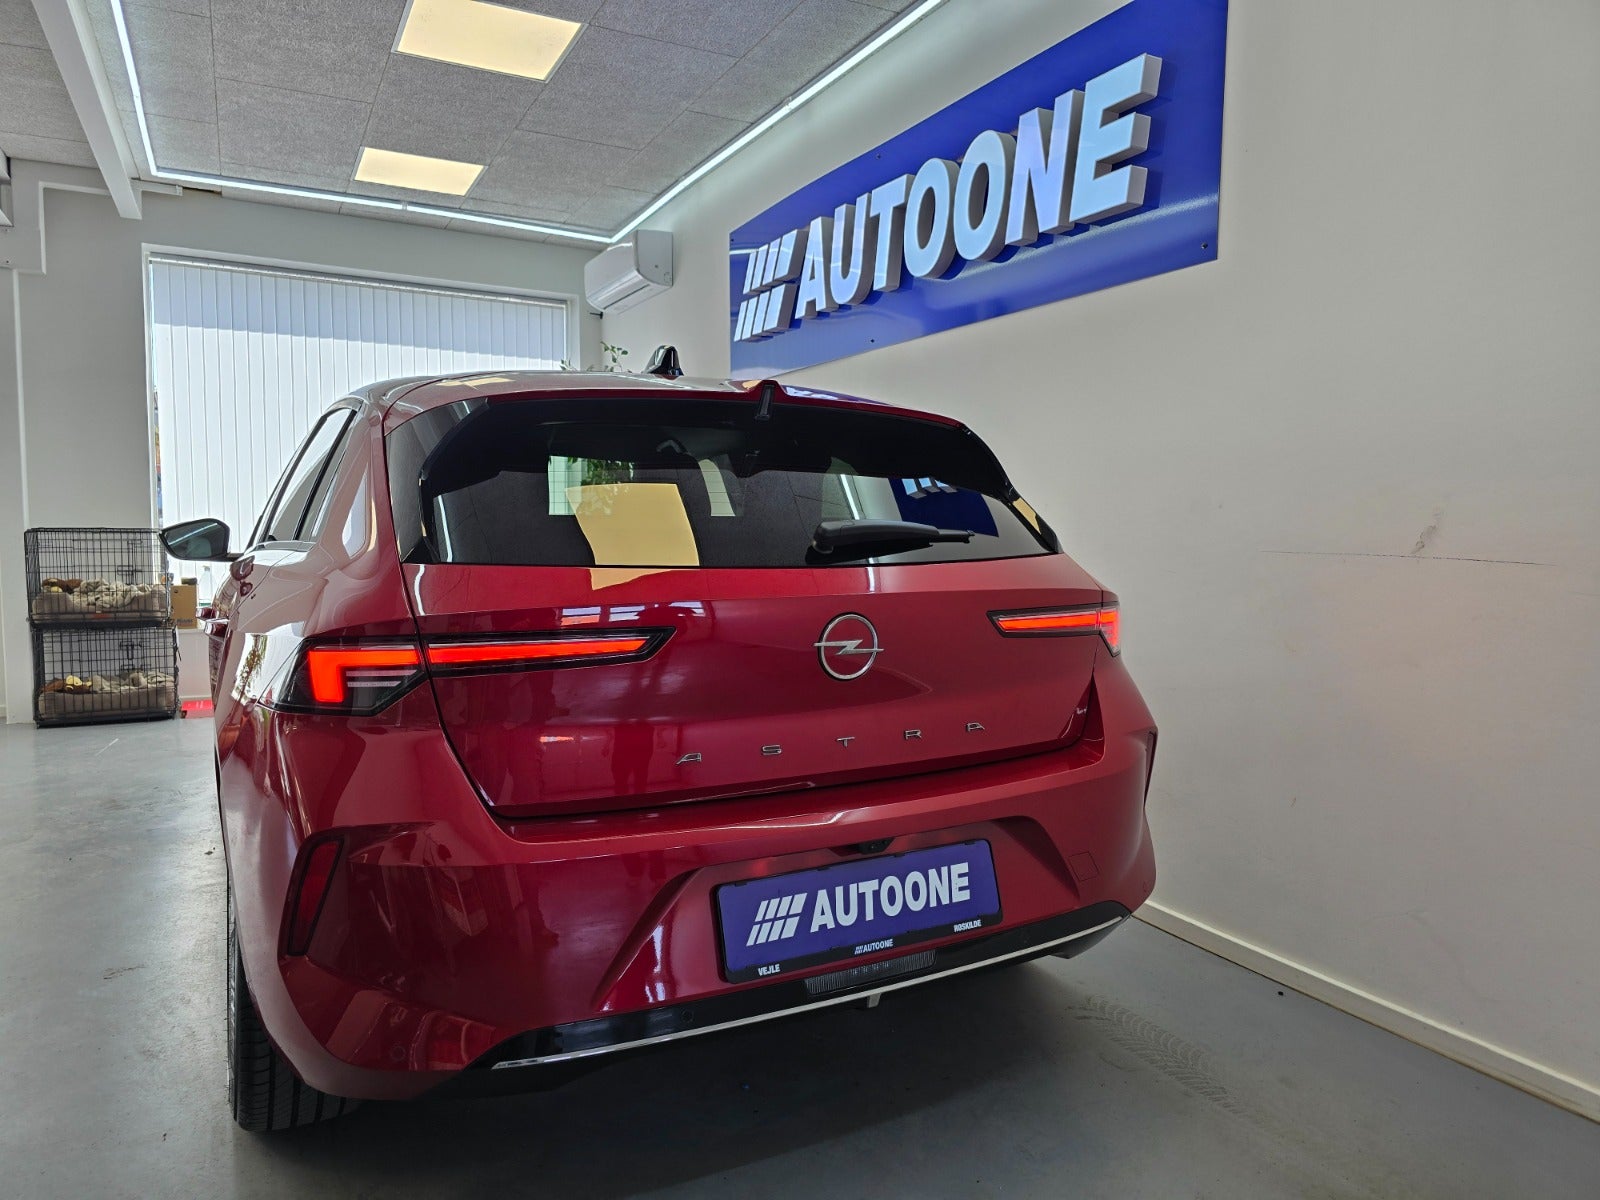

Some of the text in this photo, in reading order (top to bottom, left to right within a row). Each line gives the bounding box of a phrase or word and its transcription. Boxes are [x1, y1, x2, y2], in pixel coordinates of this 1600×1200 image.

[795, 53, 1162, 319] AUTOONE
[676, 722, 985, 765] ASTRA
[810, 862, 970, 932] AUTOONE
[863, 938, 893, 953] AUTOONE
[758, 963, 781, 976] VEJLE
